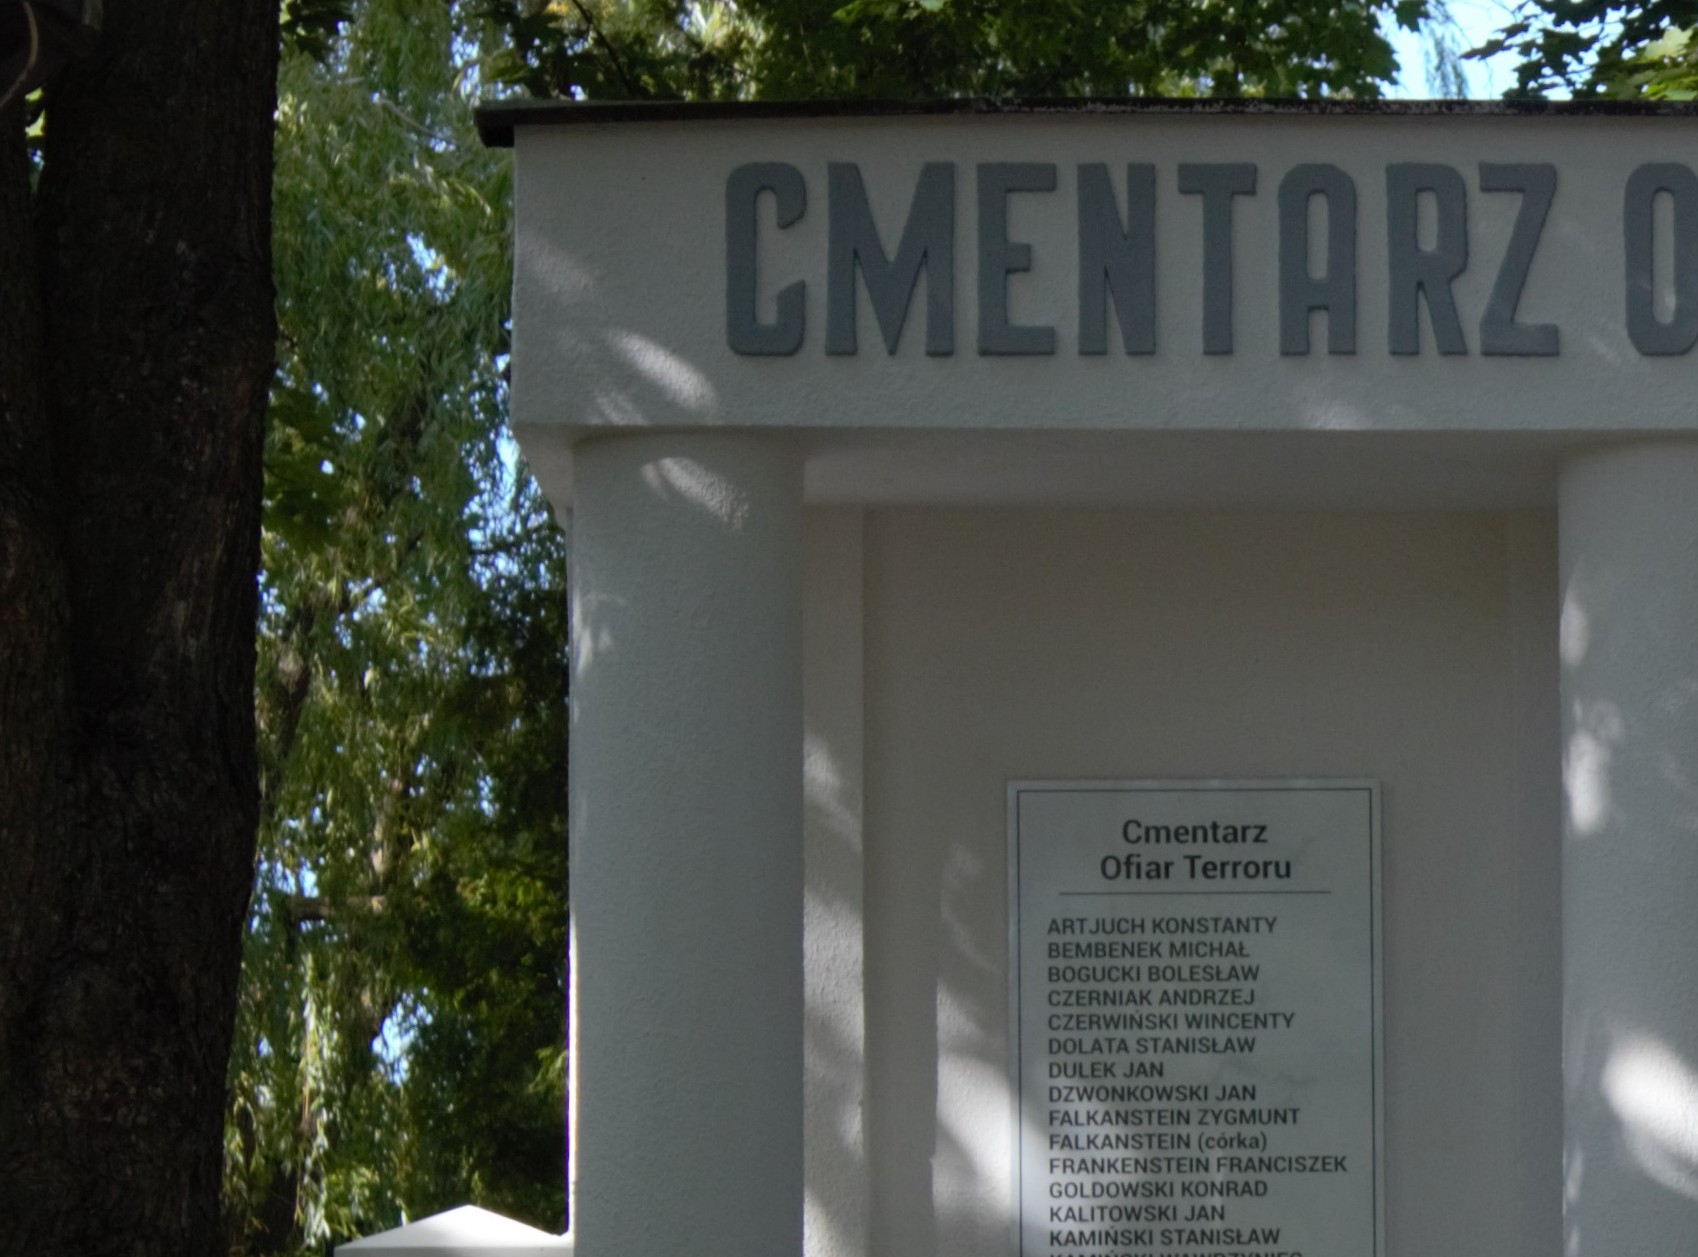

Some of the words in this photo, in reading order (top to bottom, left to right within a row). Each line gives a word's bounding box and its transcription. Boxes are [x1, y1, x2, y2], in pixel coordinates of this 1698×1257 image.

[725, 160, 1560, 357] CMENTARZ
[1122, 819, 1268, 844] Cmentarz
[1101, 854, 1174, 880] Ofiar
[1184, 855, 1291, 879] Terroru
[1047, 918, 1145, 935] ARTJUCH
[1152, 917, 1277, 934] KONSTANTY
[1048, 942, 1162, 959] BEMBENEK
[1169, 941, 1250, 958] MICHAŁ
[1048, 966, 1140, 983] BOGUCKI
[1148, 965, 1260, 982] BOLESŁAW
[1048, 990, 1152, 1007] CZERNIAK
[1159, 989, 1256, 1006] ANDRZEJ
[1048, 1009, 1178, 1031] CZERWIŃSKI
[1184, 1012, 1295, 1029] WINCENTY
[1049, 1038, 1129, 1054] DOLATA
[1136, 1037, 1256, 1054] STANISŁAW
[1049, 1062, 1116, 1078] DULEK
[1122, 1061, 1164, 1078] JAN
[1049, 1085, 1208, 1102] DZWONKOWSKI
[1216, 1085, 1256, 1101] JAN
[1049, 1109, 1190, 1126] FALKANSTEIN
[1198, 1108, 1301, 1125] ZYGMUNT
[1049, 1133, 1190, 1150] FALKANSTEIN
[1198, 1131, 1268, 1153] (córka)
[1049, 1157, 1209, 1174] FRANKENSTEIN
[1216, 1156, 1347, 1173] FRANCISZEK
[1049, 1181, 1174, 1198] GOLDOWSKI
[1181, 1180, 1268, 1197] KONRAD
[1050, 1205, 1177, 1222] KALITOWSKI
[1184, 1205, 1225, 1222] JAN
[1050, 1225, 1152, 1246] KAMIŃSKI
[1161, 1228, 1280, 1245] STANISŁAW
